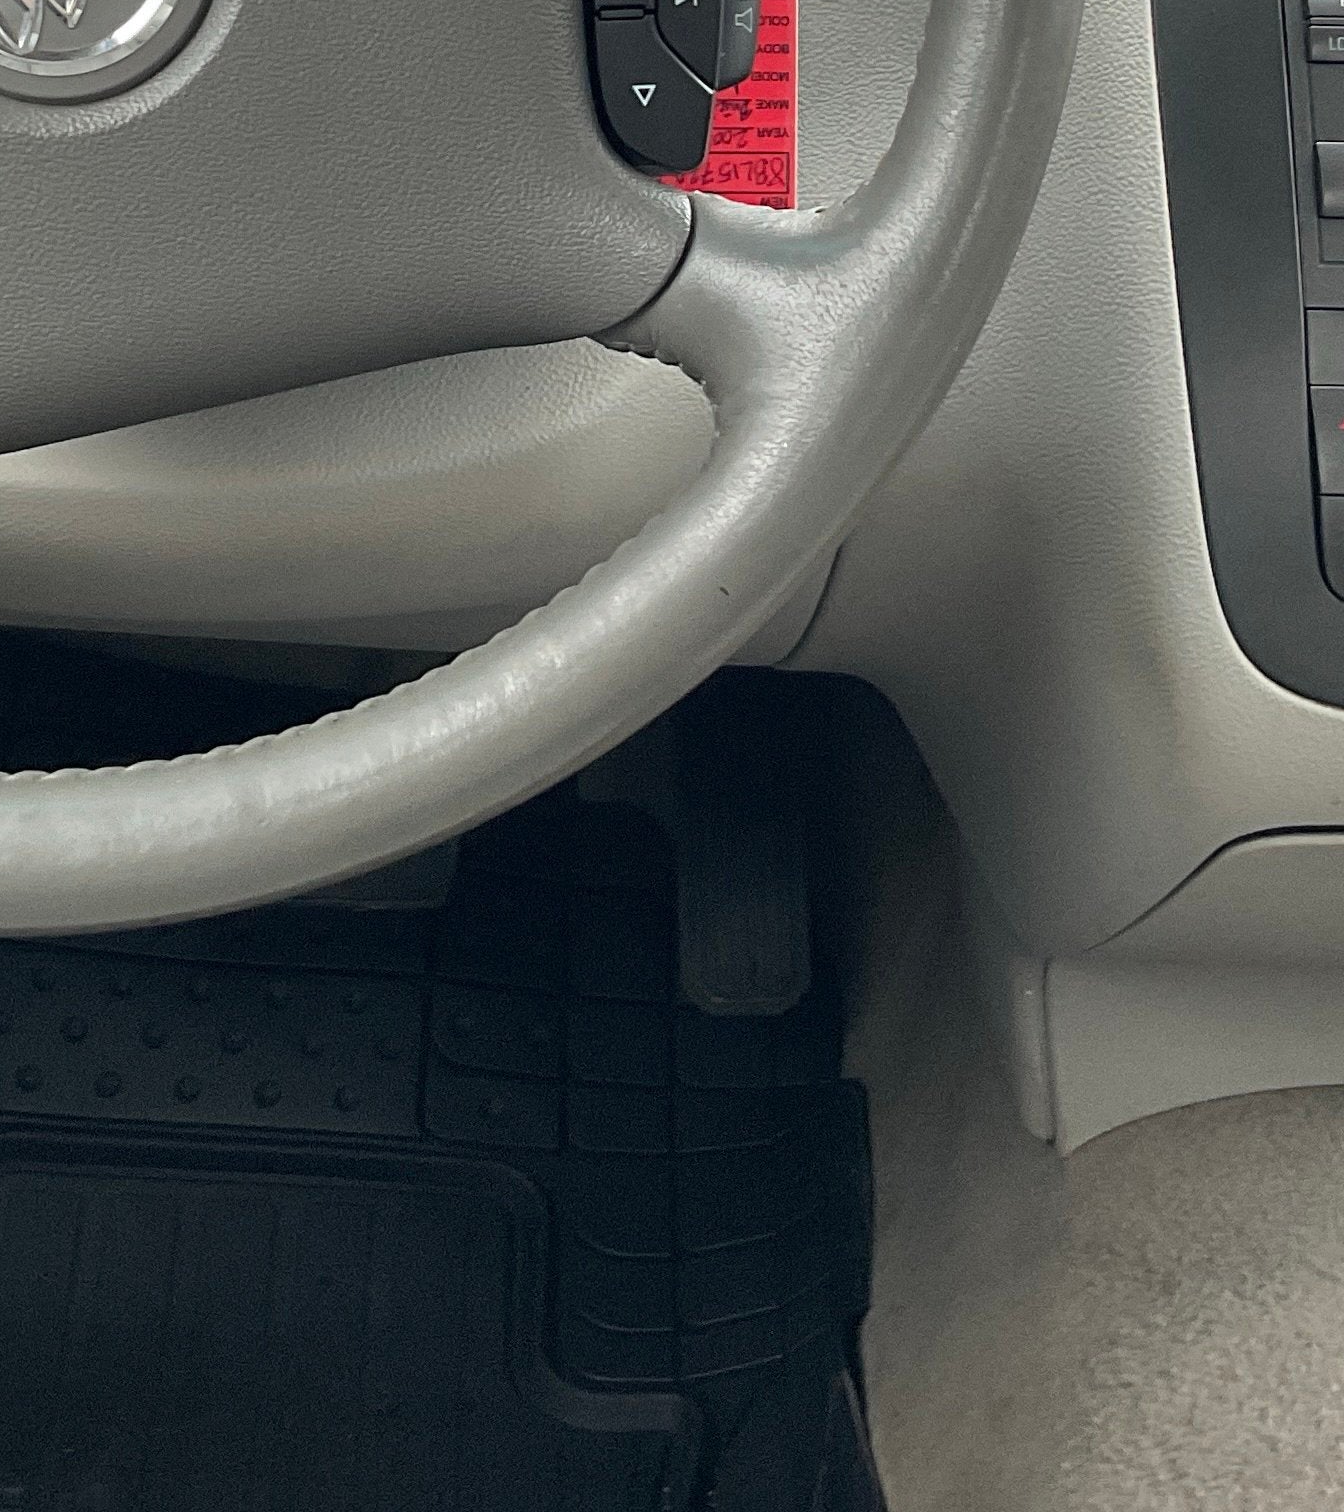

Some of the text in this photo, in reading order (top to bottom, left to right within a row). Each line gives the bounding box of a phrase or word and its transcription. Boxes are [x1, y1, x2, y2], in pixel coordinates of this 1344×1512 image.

[759, 16, 790, 27] COL
[757, 44, 790, 55] BODY
[756, 99, 790, 111] MAKE
[712, 128, 750, 149] 200
[757, 128, 790, 138] YEAR
[760, 197, 789, 207] NEW
